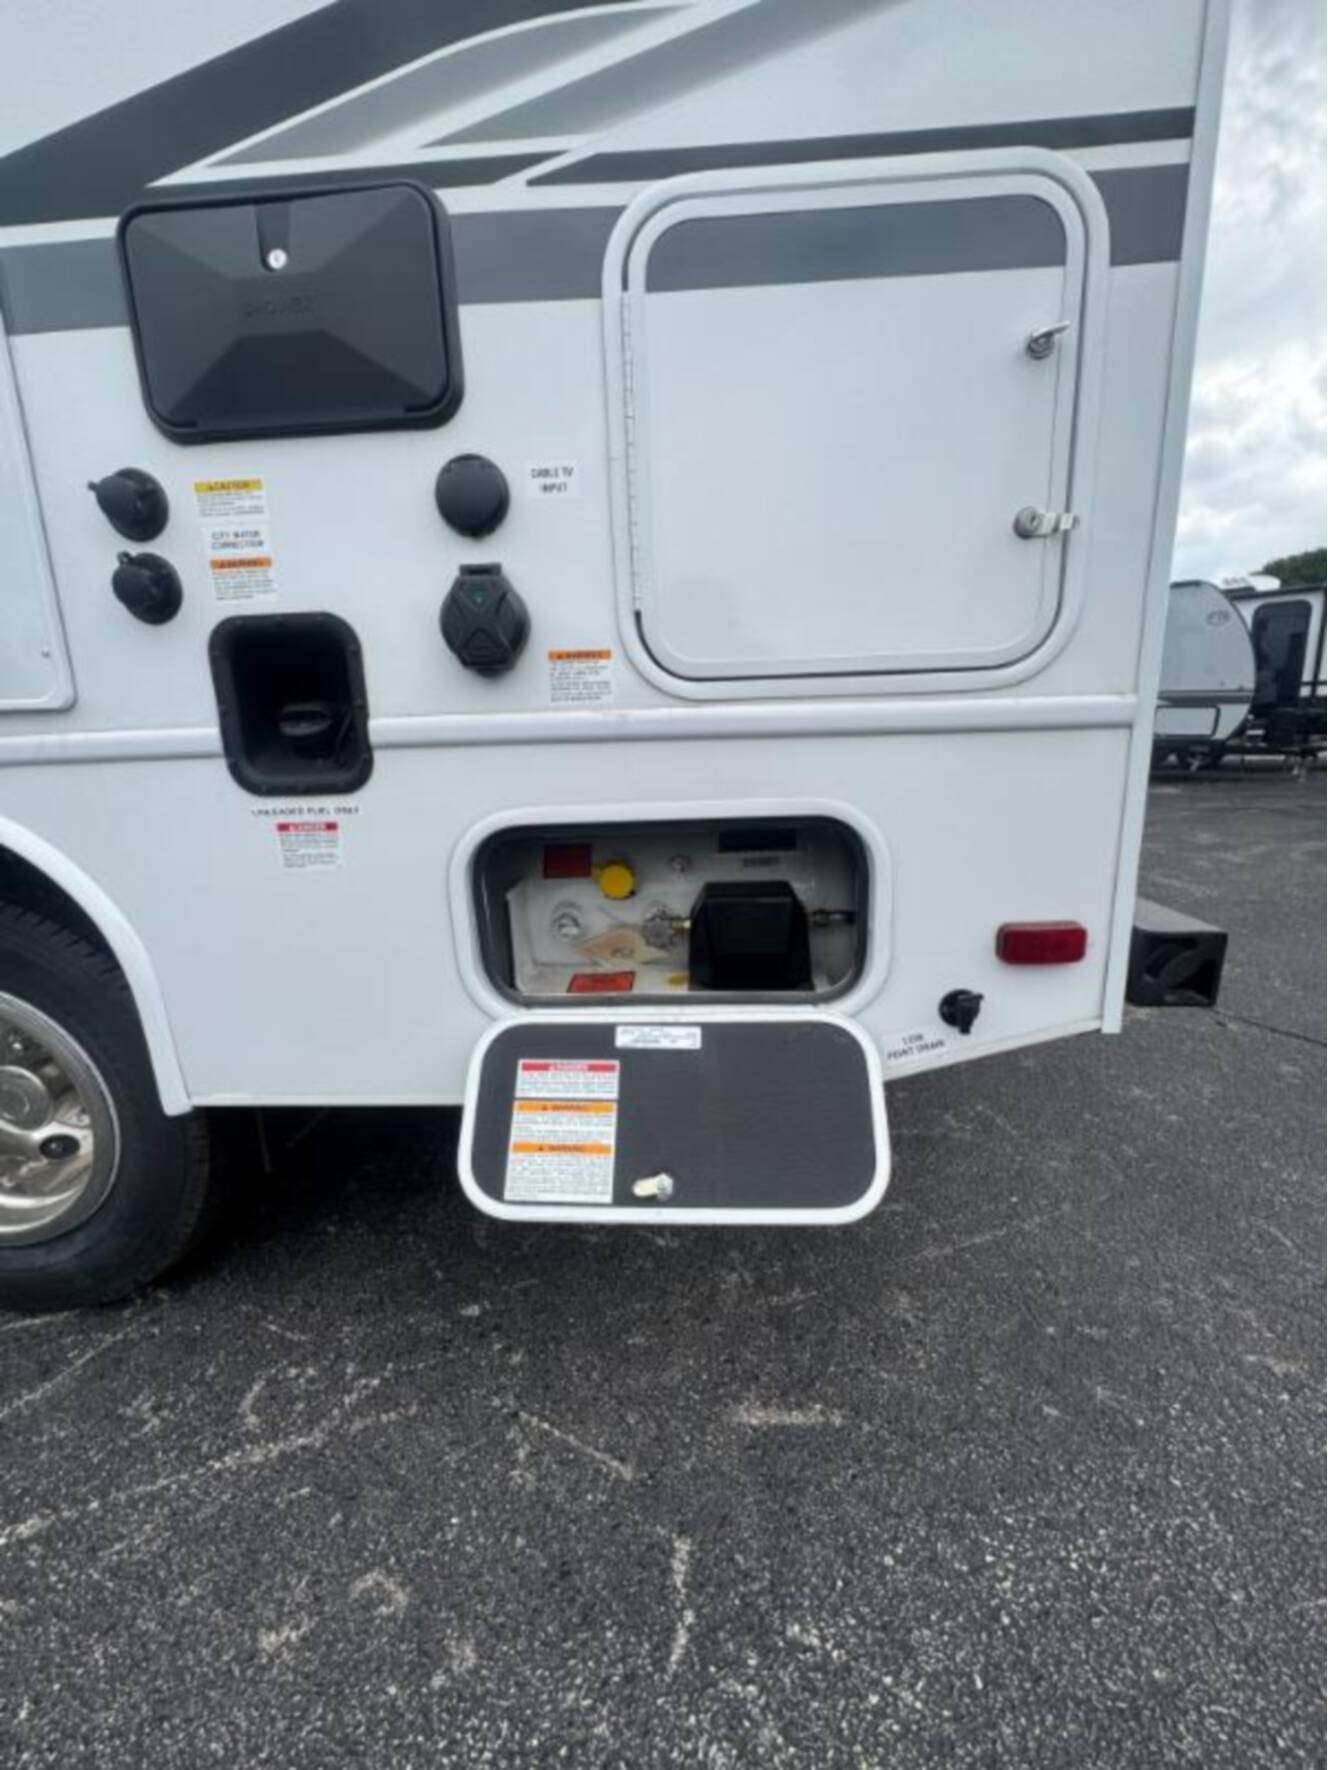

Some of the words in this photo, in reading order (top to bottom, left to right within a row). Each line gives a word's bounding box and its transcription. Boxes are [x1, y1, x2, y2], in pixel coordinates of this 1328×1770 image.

[531, 467, 559, 479] CABLE
[561, 466, 575, 477] TV
[540, 482, 567, 493] INPUT
[211, 531, 230, 540] CITY
[233, 530, 260, 539] WATER
[307, 806, 331, 815] FUEL
[334, 805, 359, 815] ONLY
